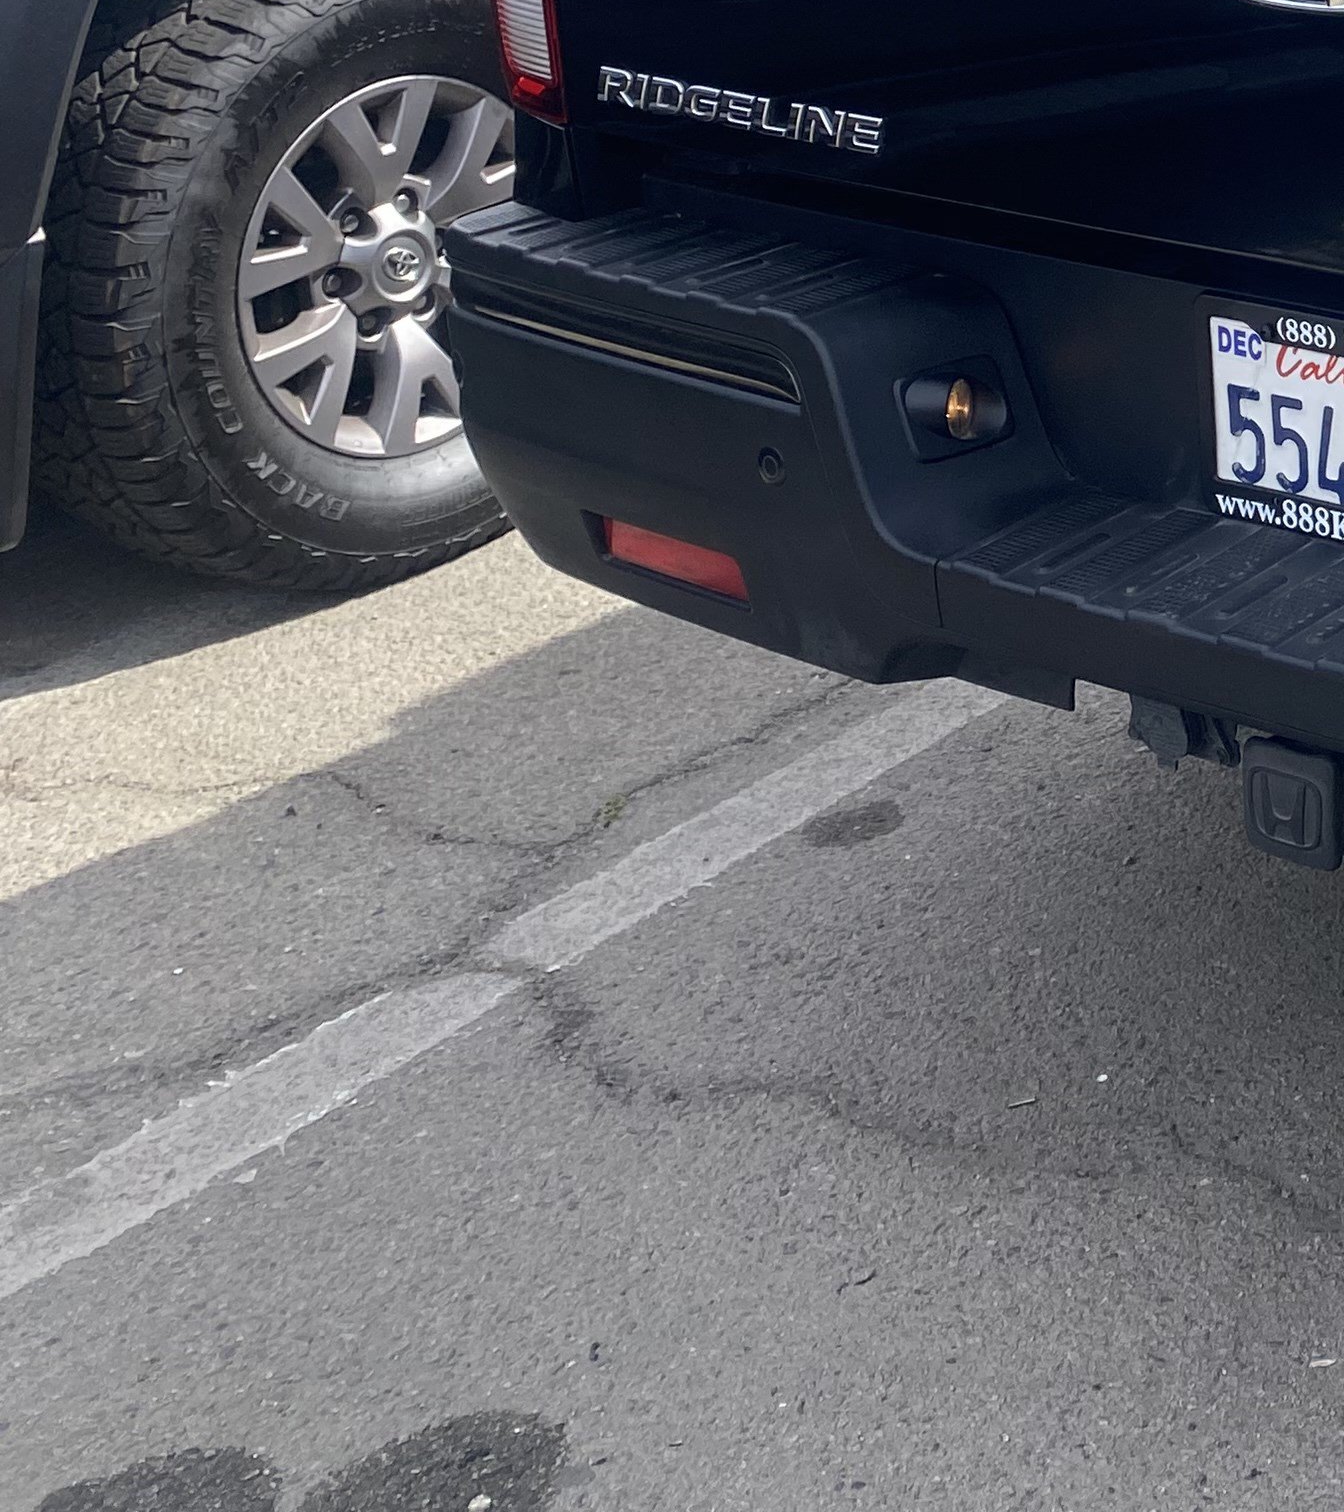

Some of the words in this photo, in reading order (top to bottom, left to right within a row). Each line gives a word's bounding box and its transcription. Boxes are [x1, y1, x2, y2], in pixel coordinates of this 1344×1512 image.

[597, 65, 883, 155] RIDGELINE
[1217, 325, 1263, 361] DEC
[1276, 316, 1337, 349] (888)
[242, 448, 350, 521] BACK
